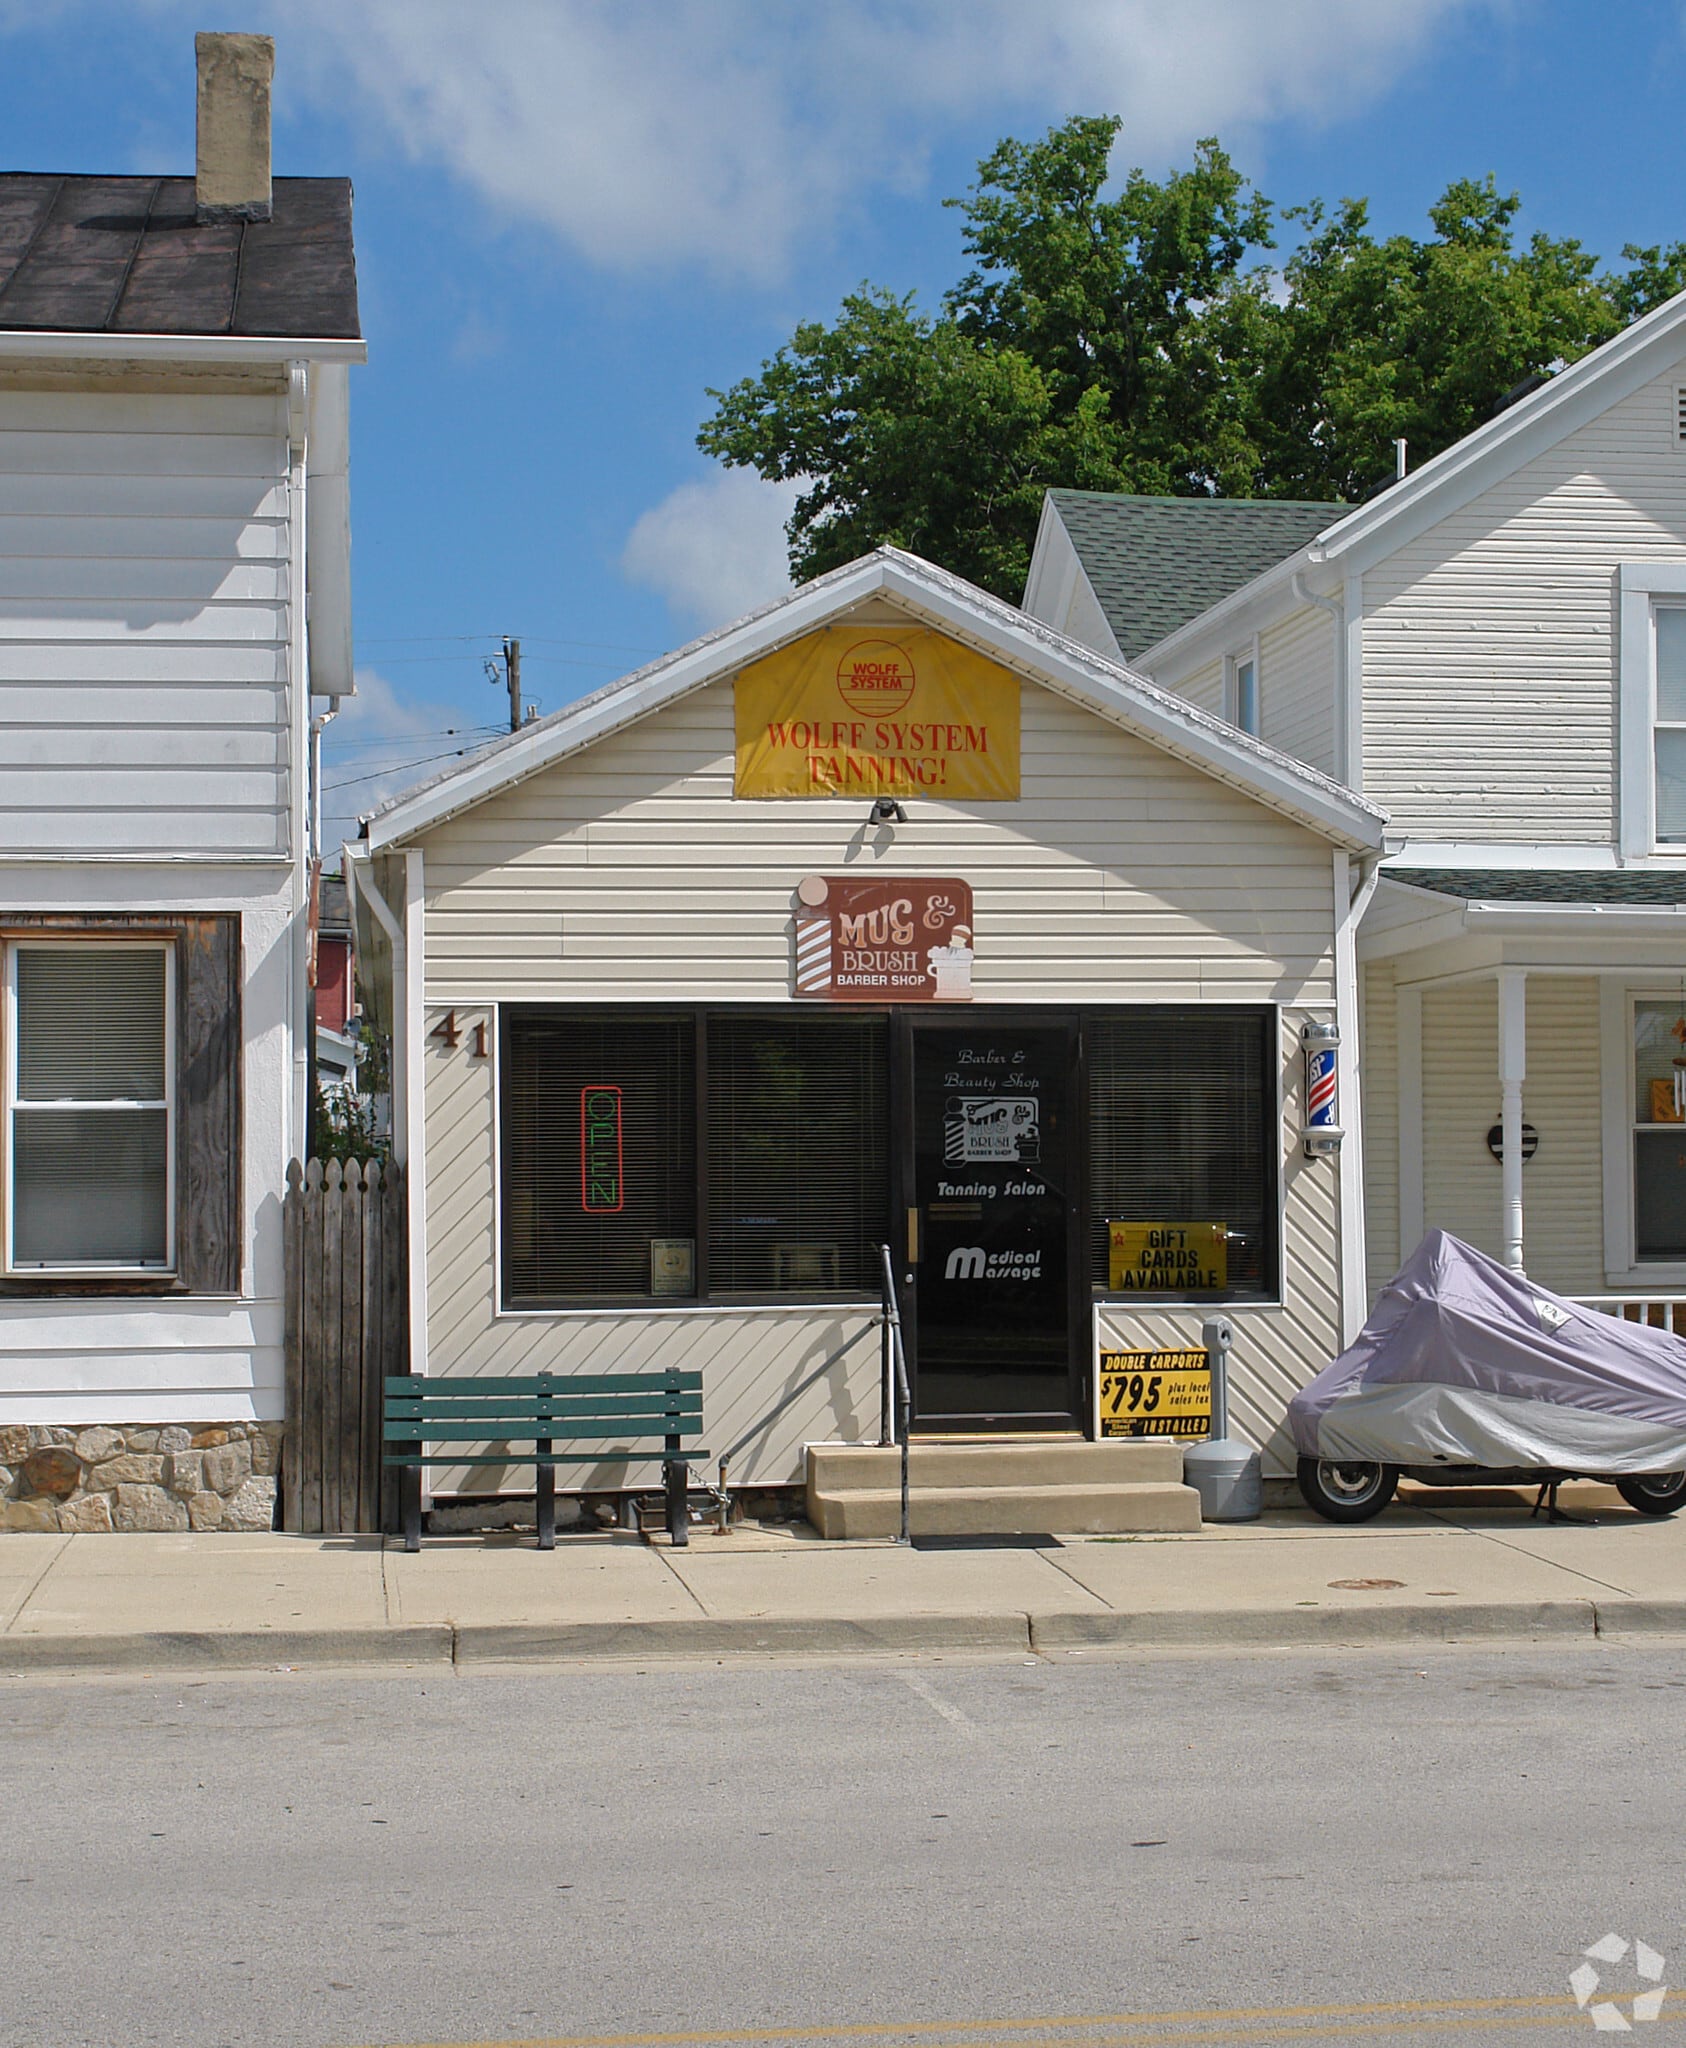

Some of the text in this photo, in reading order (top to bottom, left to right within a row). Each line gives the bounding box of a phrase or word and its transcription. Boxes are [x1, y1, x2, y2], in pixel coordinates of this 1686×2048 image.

[853, 663, 899, 675] WOLFF
[850, 676, 902, 689] SYSTEM
[768, 721, 988, 752] WOLFF SYSTEM
[805, 756, 946, 785] TANNING!
[838, 895, 956, 948] MUG &
[842, 951, 918, 972] BRUSH
[837, 975, 926, 986] BARBER SHOP
[430, 1010, 488, 1058] 41
[957, 1049, 1026, 1064] Barber &
[944, 1073, 1040, 1092] Beauty Shop
[588, 1093, 616, 1204] OPEN
[971, 1137, 1009, 1148] BRUSH
[938, 1181, 1046, 1198] Tanning Salon
[1149, 1230, 1187, 1248] GIFT
[1141, 1250, 1198, 1269] CARDS
[1123, 1270, 1218, 1289] AVAILABLE
[1105, 1355, 1205, 1371] DOUBLE CARPORTS
[1101, 1375, 1162, 1413] $795
[1168, 1381, 1210, 1395] plus local
[1170, 1395, 1209, 1405] sales tax
[1143, 1418, 1208, 1434] INSTALLED
